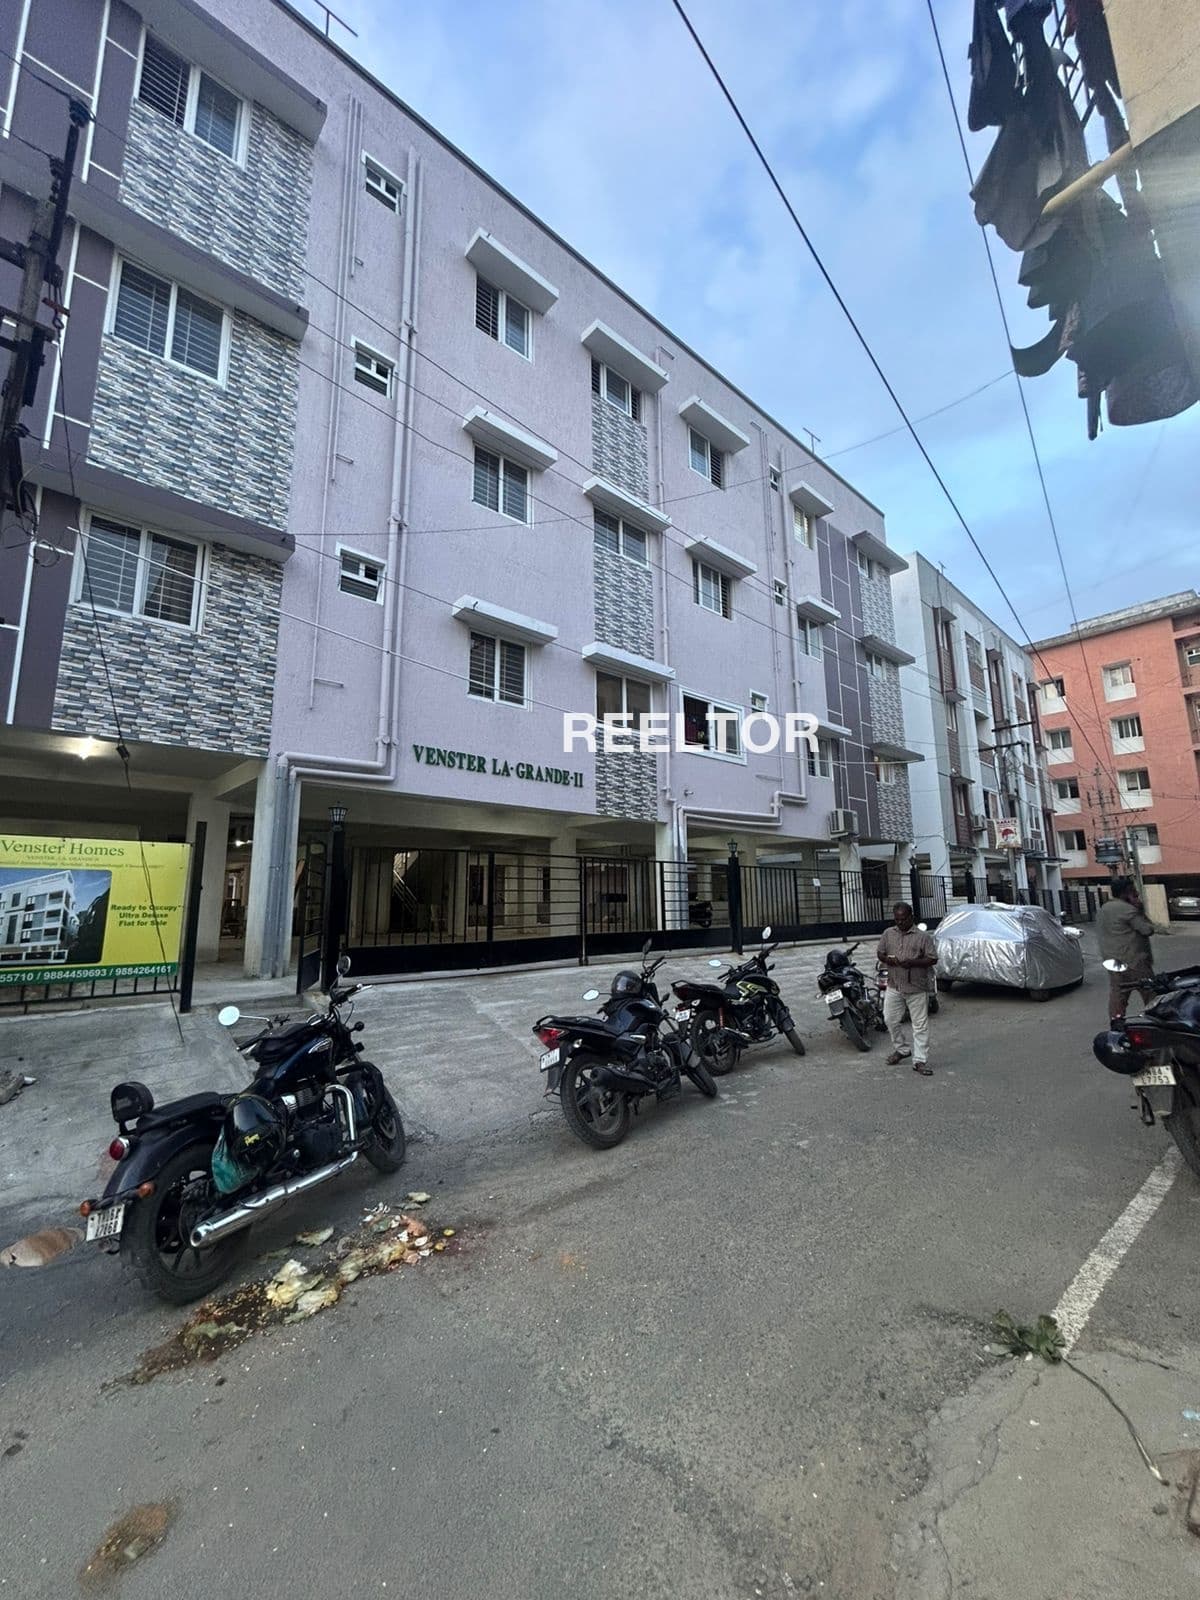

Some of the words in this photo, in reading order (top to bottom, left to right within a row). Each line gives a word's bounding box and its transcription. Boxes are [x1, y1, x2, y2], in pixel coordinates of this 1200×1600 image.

[412, 744, 487, 774] VENSTER
[1, 840, 65, 854] Venster
[70, 843, 125, 856] Homes
